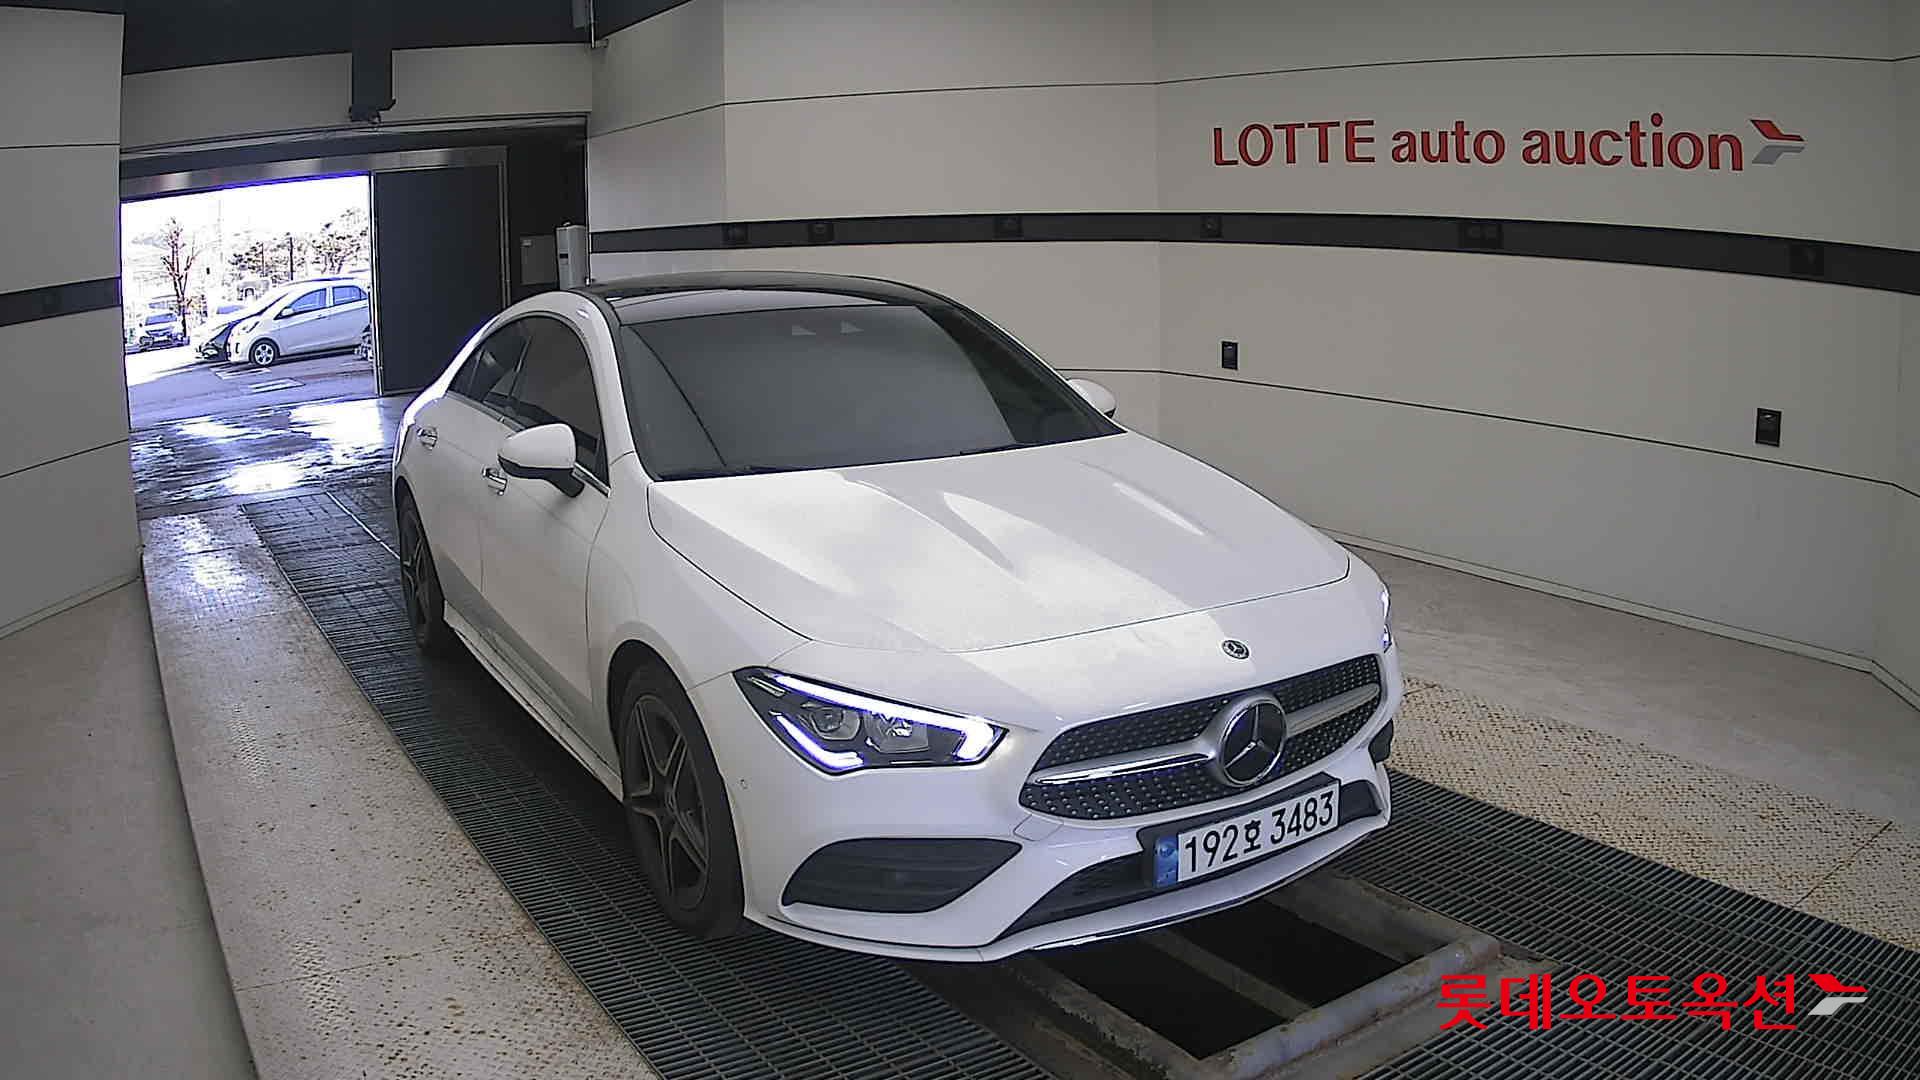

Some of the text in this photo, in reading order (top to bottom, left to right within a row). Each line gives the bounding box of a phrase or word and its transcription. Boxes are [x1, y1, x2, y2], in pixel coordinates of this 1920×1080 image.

[1212, 112, 1743, 171] LOTTE auto auction
[1184, 790, 1334, 873] 192호 3483
